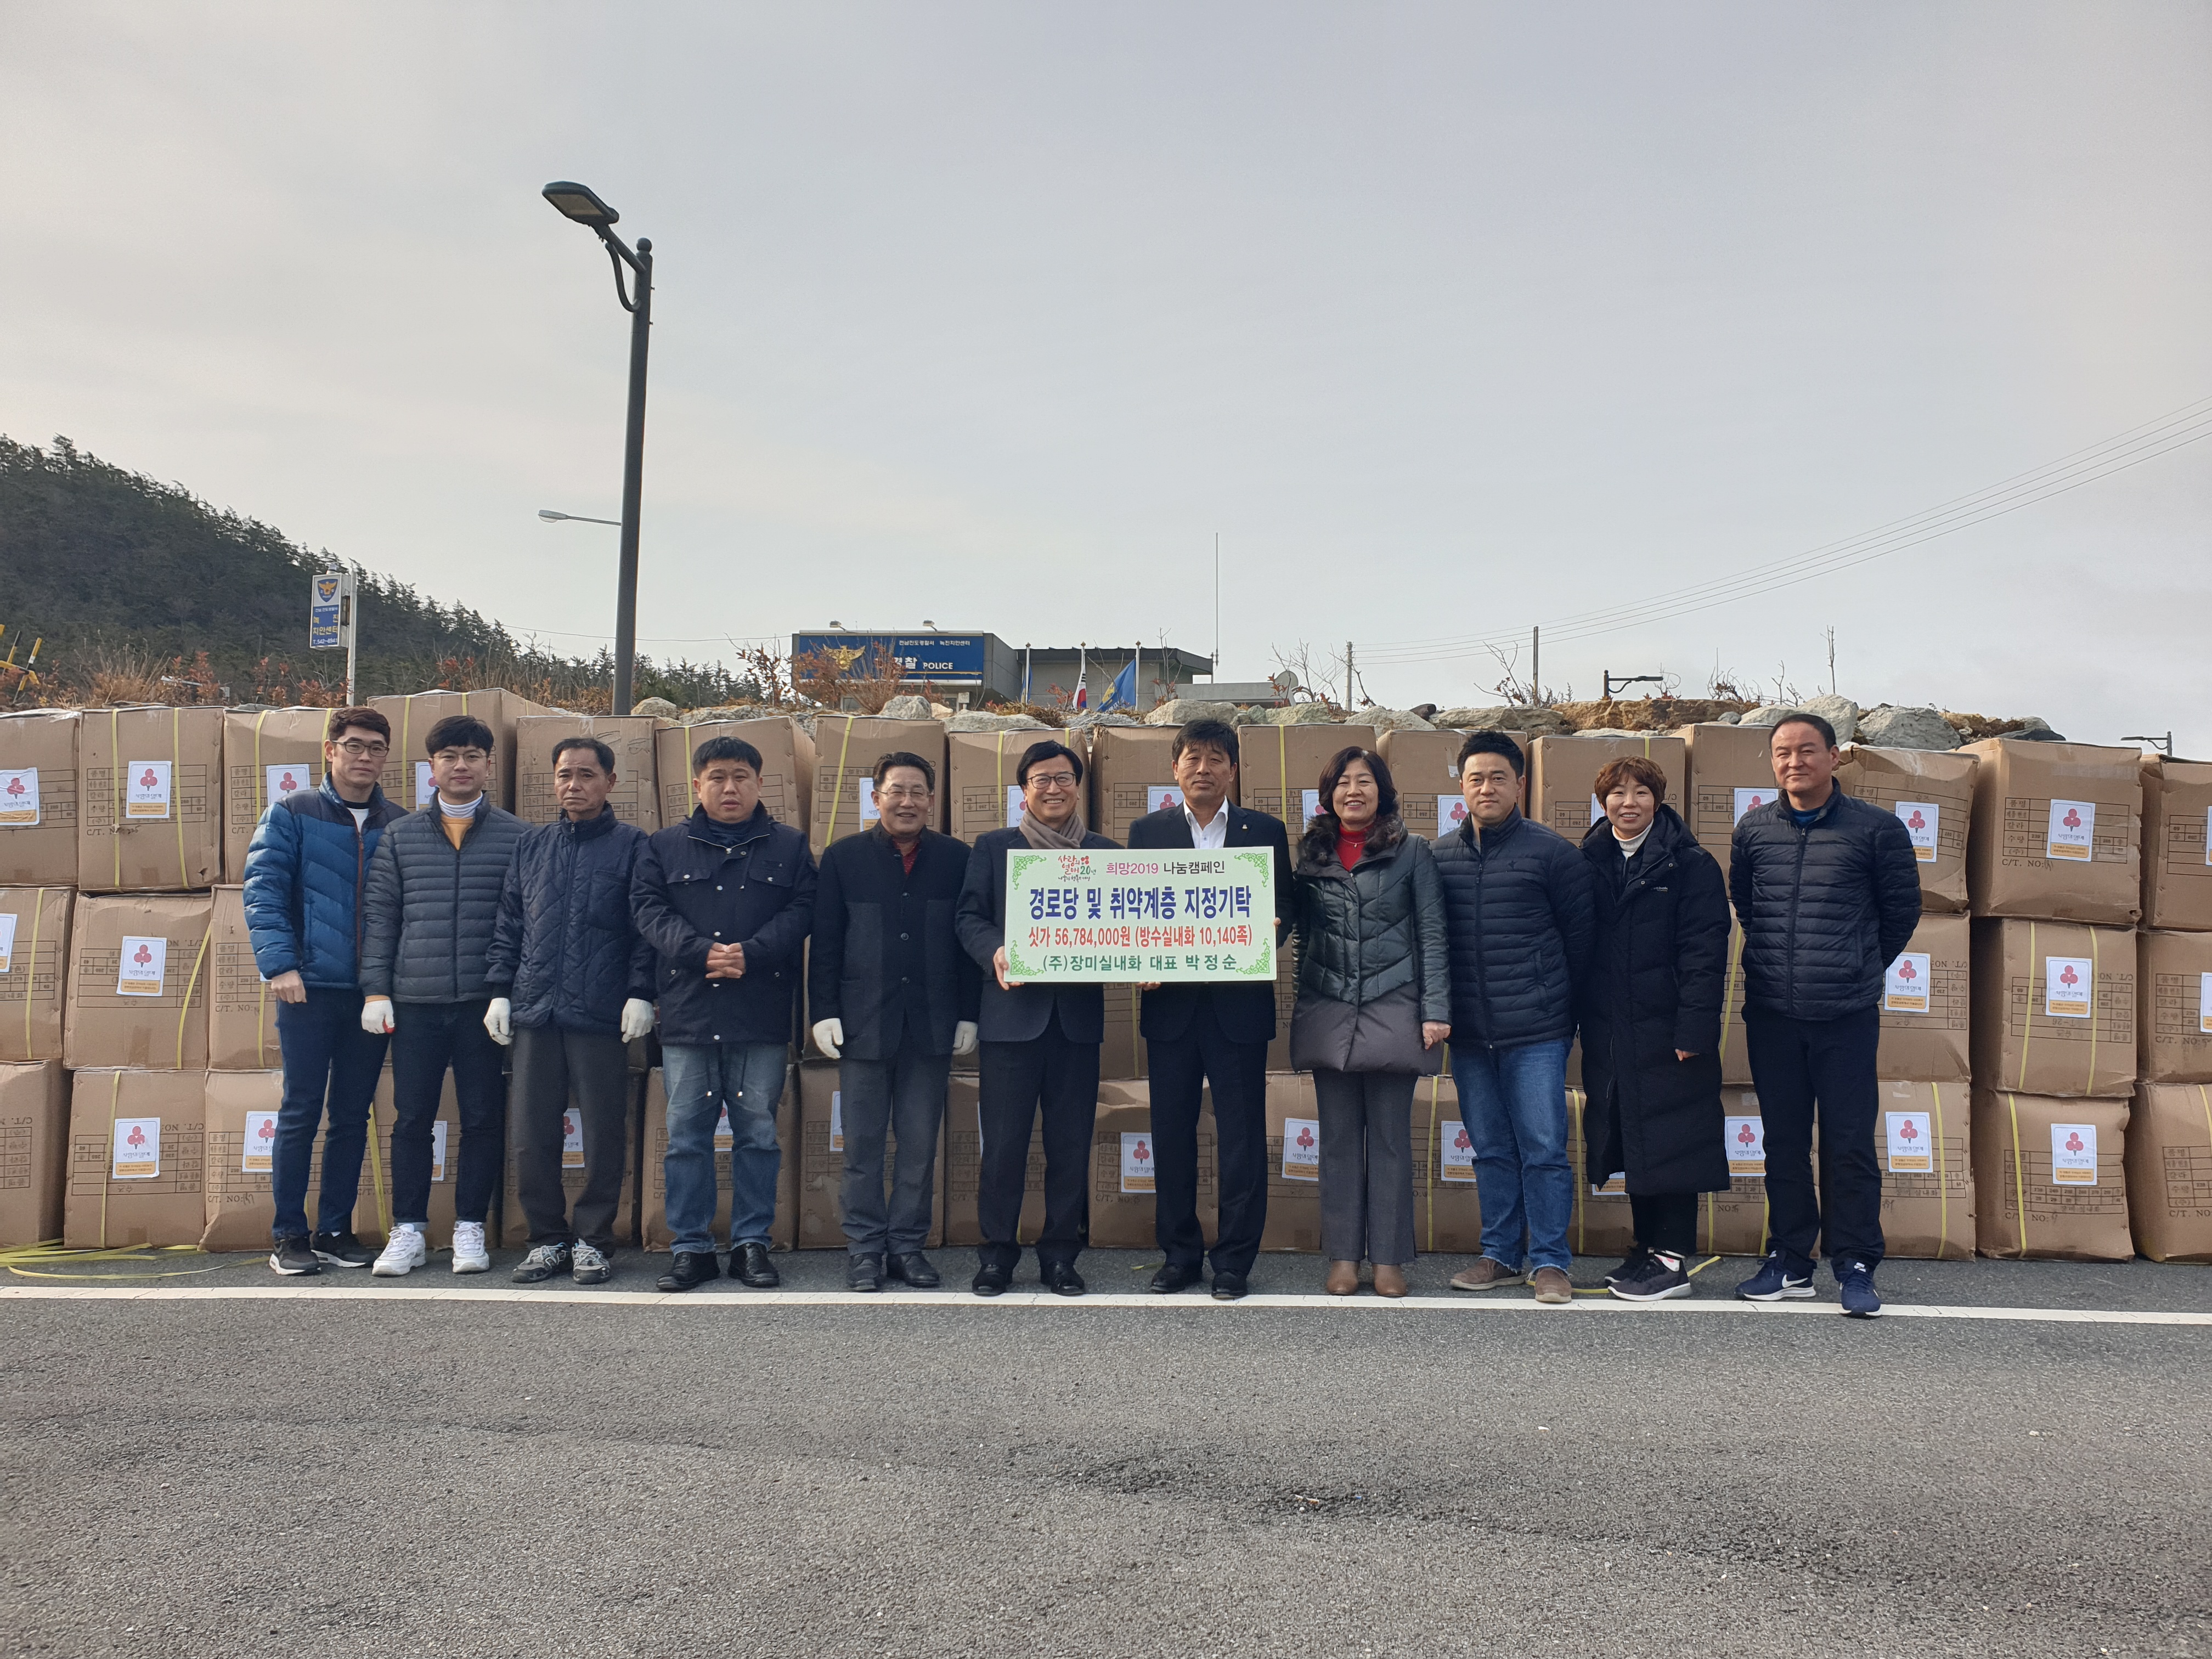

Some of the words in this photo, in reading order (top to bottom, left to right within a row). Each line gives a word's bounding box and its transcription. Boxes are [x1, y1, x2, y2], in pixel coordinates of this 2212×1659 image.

[232, 826, 249, 834] C/T.
[1105, 861, 1159, 875] 희망2019
[1163, 860, 1225, 875] 나눔캠페인
[2002, 859, 2022, 867] C/T.
[2027, 859, 2044, 868] NO:
[1029, 887, 1079, 920] 경로당
[1086, 886, 1102, 919] 및
[1109, 885, 1177, 920] 취약계층
[1184, 884, 1252, 919] 지정기탁
[1028, 926, 1051, 948] 싯가
[1054, 926, 1131, 949] 56,784,000원
[1135, 925, 1195, 949] (방수실내화
[1199, 924, 1252, 946] 10,140족)
[1043, 954, 1142, 972] (주)장미실내화
[1150, 954, 1178, 972] 대표
[2118, 973, 2134, 981] C/T.
[2155, 1035, 2177, 1044] C/T.
[186, 1122, 204, 1131] C/T.
[2169, 1210, 2191, 1218] C/T.
